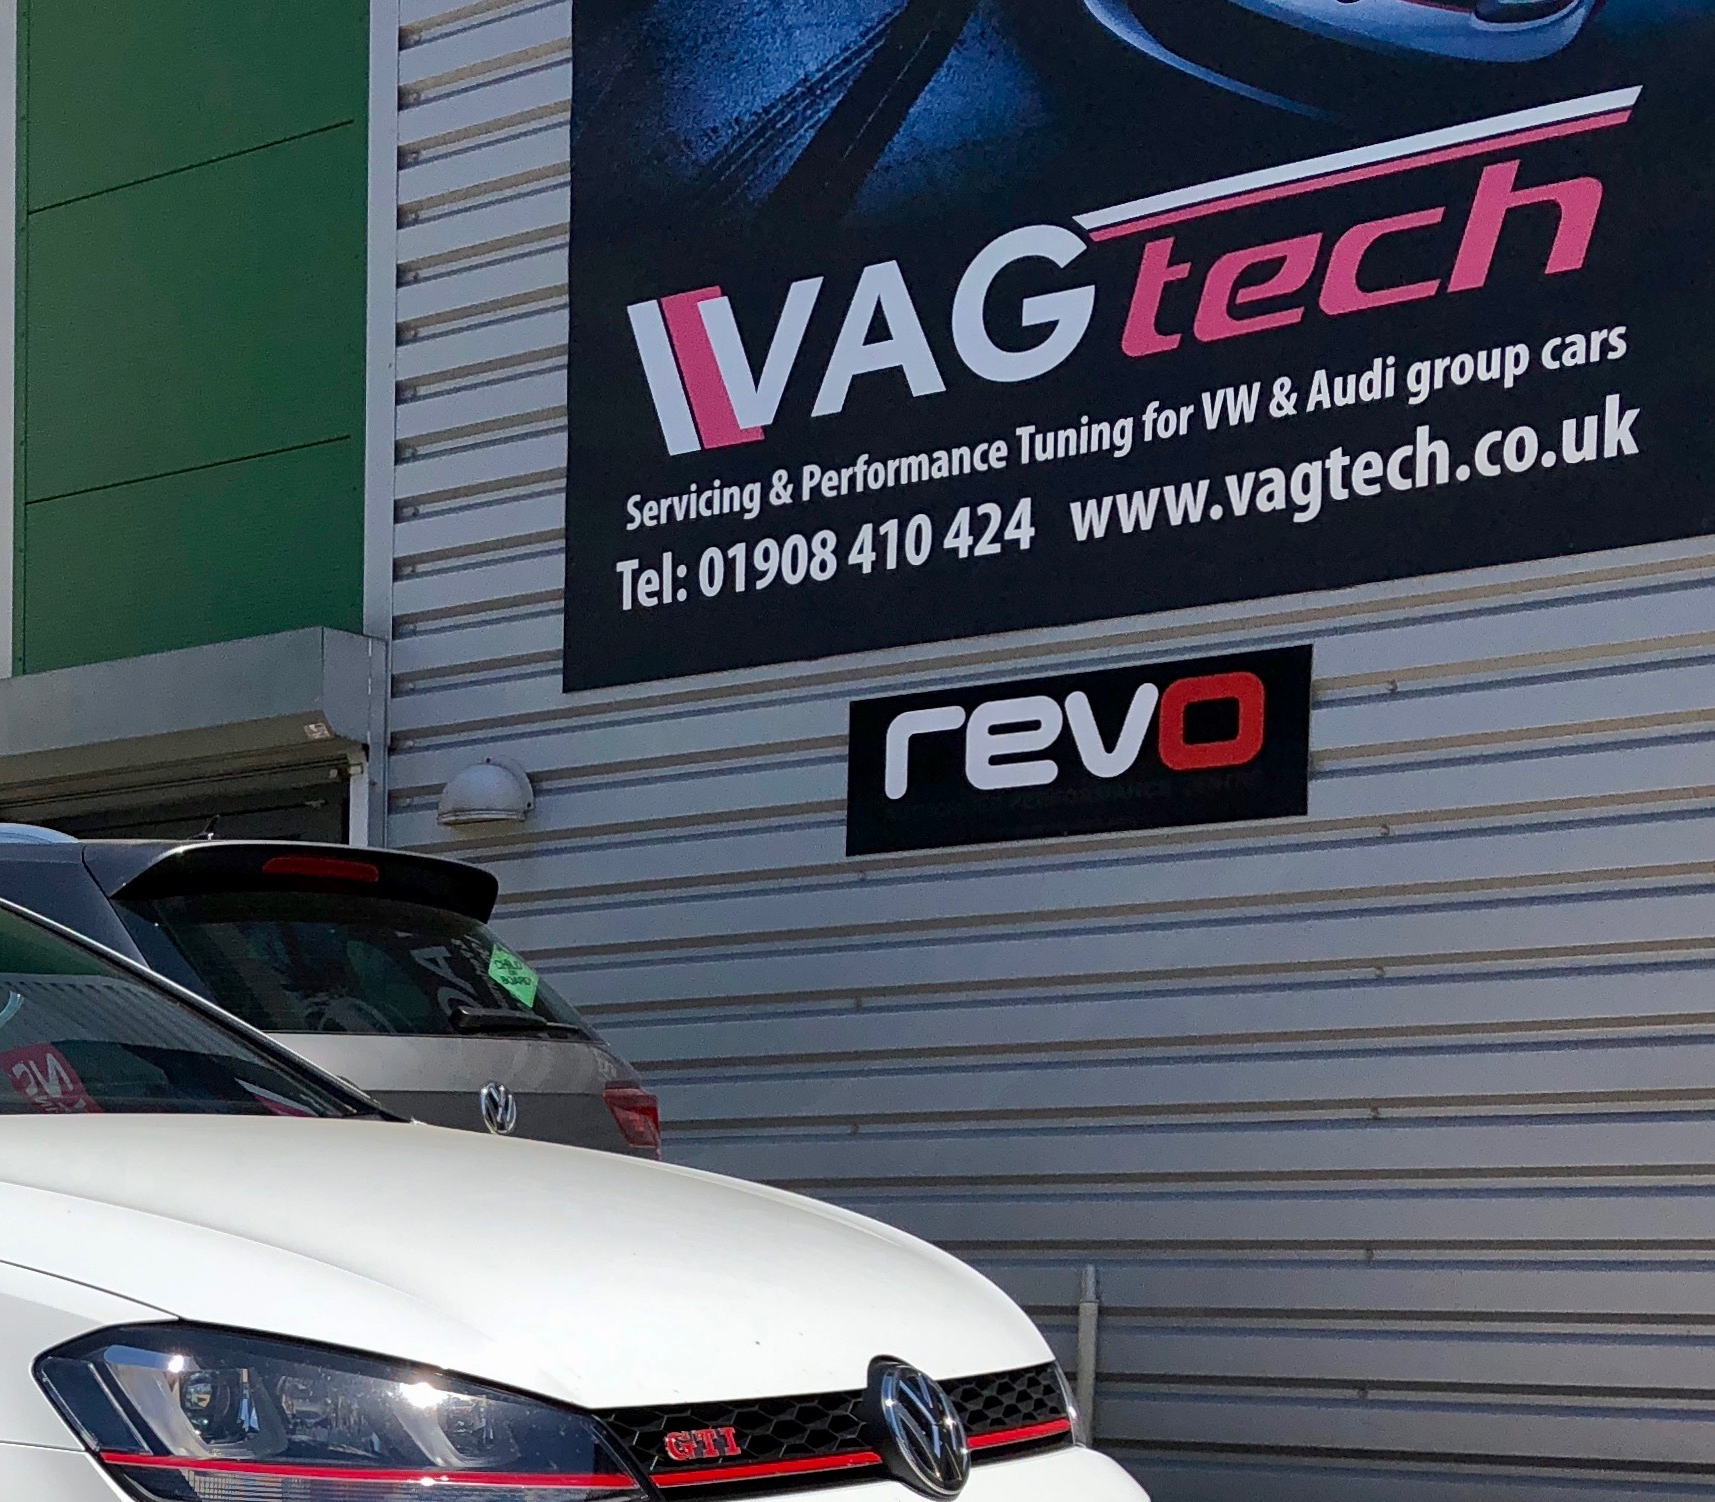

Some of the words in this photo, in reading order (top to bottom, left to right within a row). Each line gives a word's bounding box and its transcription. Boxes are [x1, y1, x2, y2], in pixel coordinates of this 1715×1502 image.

[626, 480, 761, 531] Servicing
[769, 468, 794, 506] &
[802, 440, 1007, 502] Performance
[1015, 415, 1134, 465] Tuning
[1141, 400, 1195, 442] for
[1201, 382, 1260, 431] VW
[1268, 376, 1298, 419] &
[1306, 355, 1396, 413] Audi
[1406, 343, 1530, 405] group
[1541, 325, 1627, 370] cars
[615, 551, 688, 611] Tel:
[698, 529, 838, 598] 01908
[847, 513, 933, 575] 410
[942, 496, 1036, 559] 424
[1069, 393, 1641, 541] www.vagtech.co.uk
[884, 671, 1266, 801] revo
[493, 958, 523, 970] CHILD
[500, 975, 532, 986] BOARD
[664, 1426, 742, 1462] GTI
